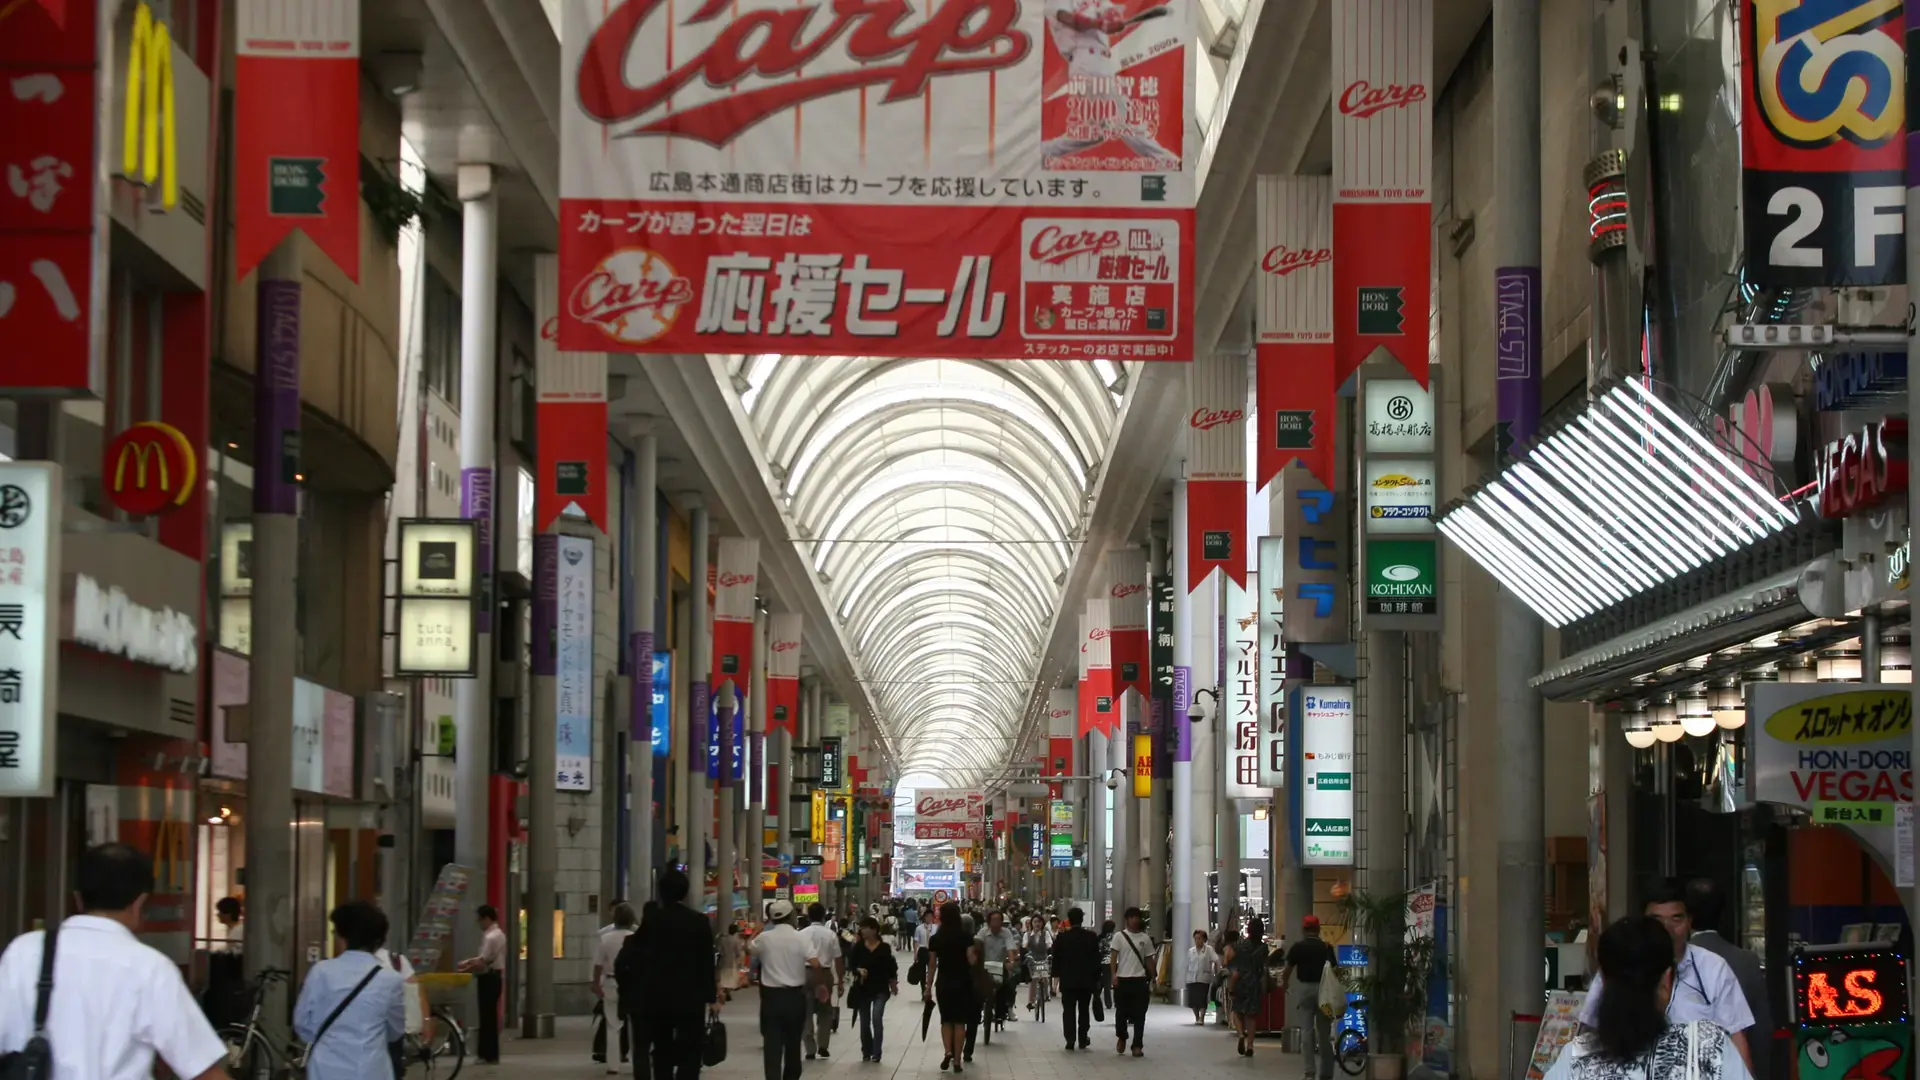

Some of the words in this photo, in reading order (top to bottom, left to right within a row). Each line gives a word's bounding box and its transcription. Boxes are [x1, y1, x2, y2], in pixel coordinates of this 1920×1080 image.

[577, 0, 1032, 149] Carp
[1339, 80, 1427, 118] Carp
[648, 171, 1101, 199] 広島本通商店街はカープを応援しています。
[1339, 190, 1380, 198] HIROSHIMA
[1383, 190, 1402, 198] TOYO
[1405, 190, 1425, 198] CARP
[578, 210, 812, 236] カープが勝った翌日は
[1029, 225, 1121, 265] Carp
[1261, 245, 1332, 276] Carp
[568, 271, 694, 325] Carp
[695, 252, 1007, 338] 応援セール
[1361, 293, 1389, 302] HON-
[1361, 302, 1389, 311] DORI
[1190, 407, 1244, 431] Carp
[1380, 602, 1423, 613] 珈琲館
[1089, 627, 1111, 641] Car
[1319, 699, 1351, 710] Kumahira
[1799, 750, 1911, 770] HON-DORI
[916, 796, 967, 817] Carp
[985, 814, 995, 839] SHIPS
